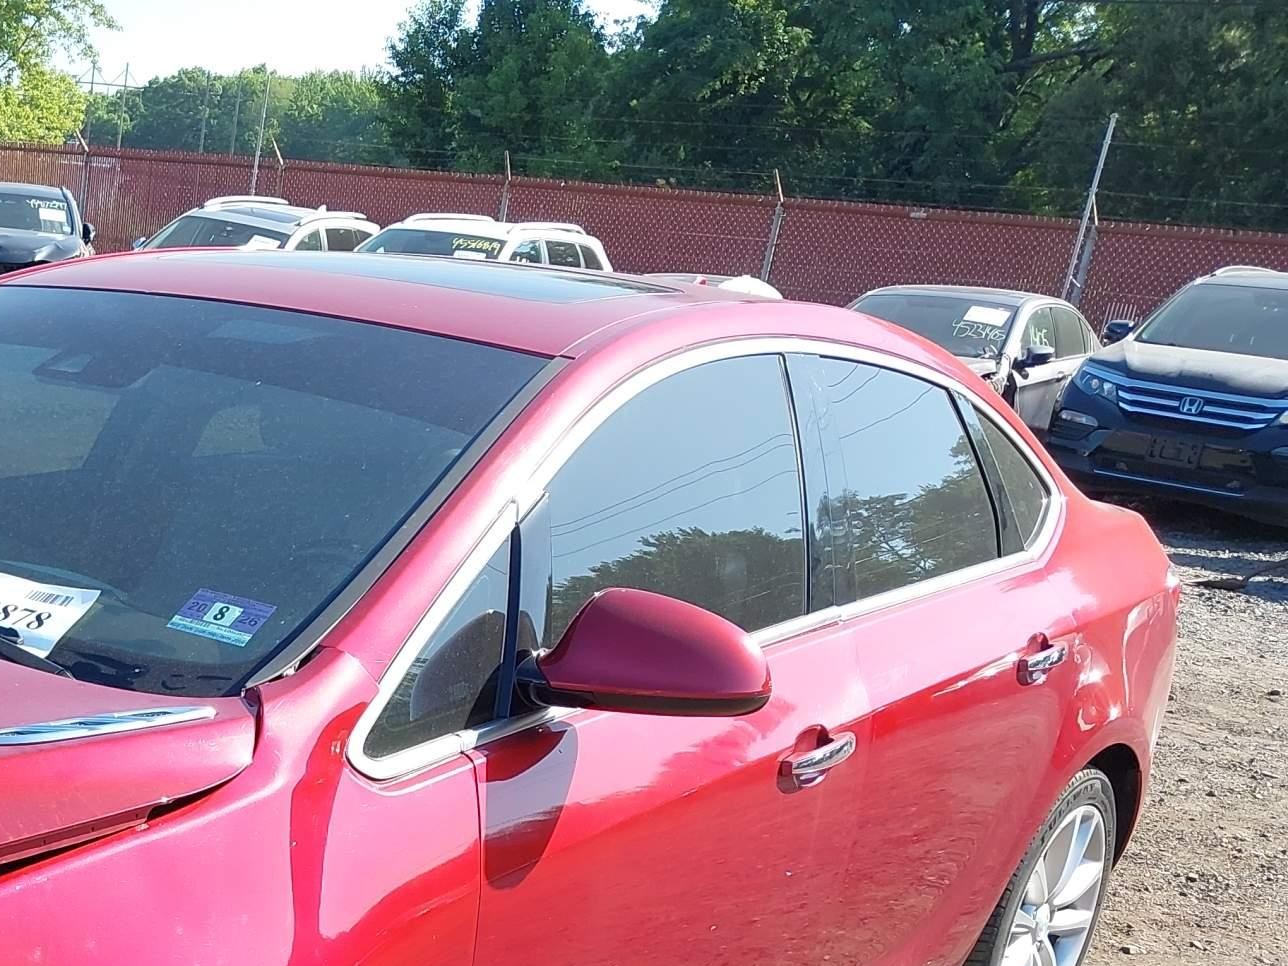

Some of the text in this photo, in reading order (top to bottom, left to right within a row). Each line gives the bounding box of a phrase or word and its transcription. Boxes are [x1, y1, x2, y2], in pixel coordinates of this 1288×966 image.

[187, 601, 258, 627] 20 8 26
